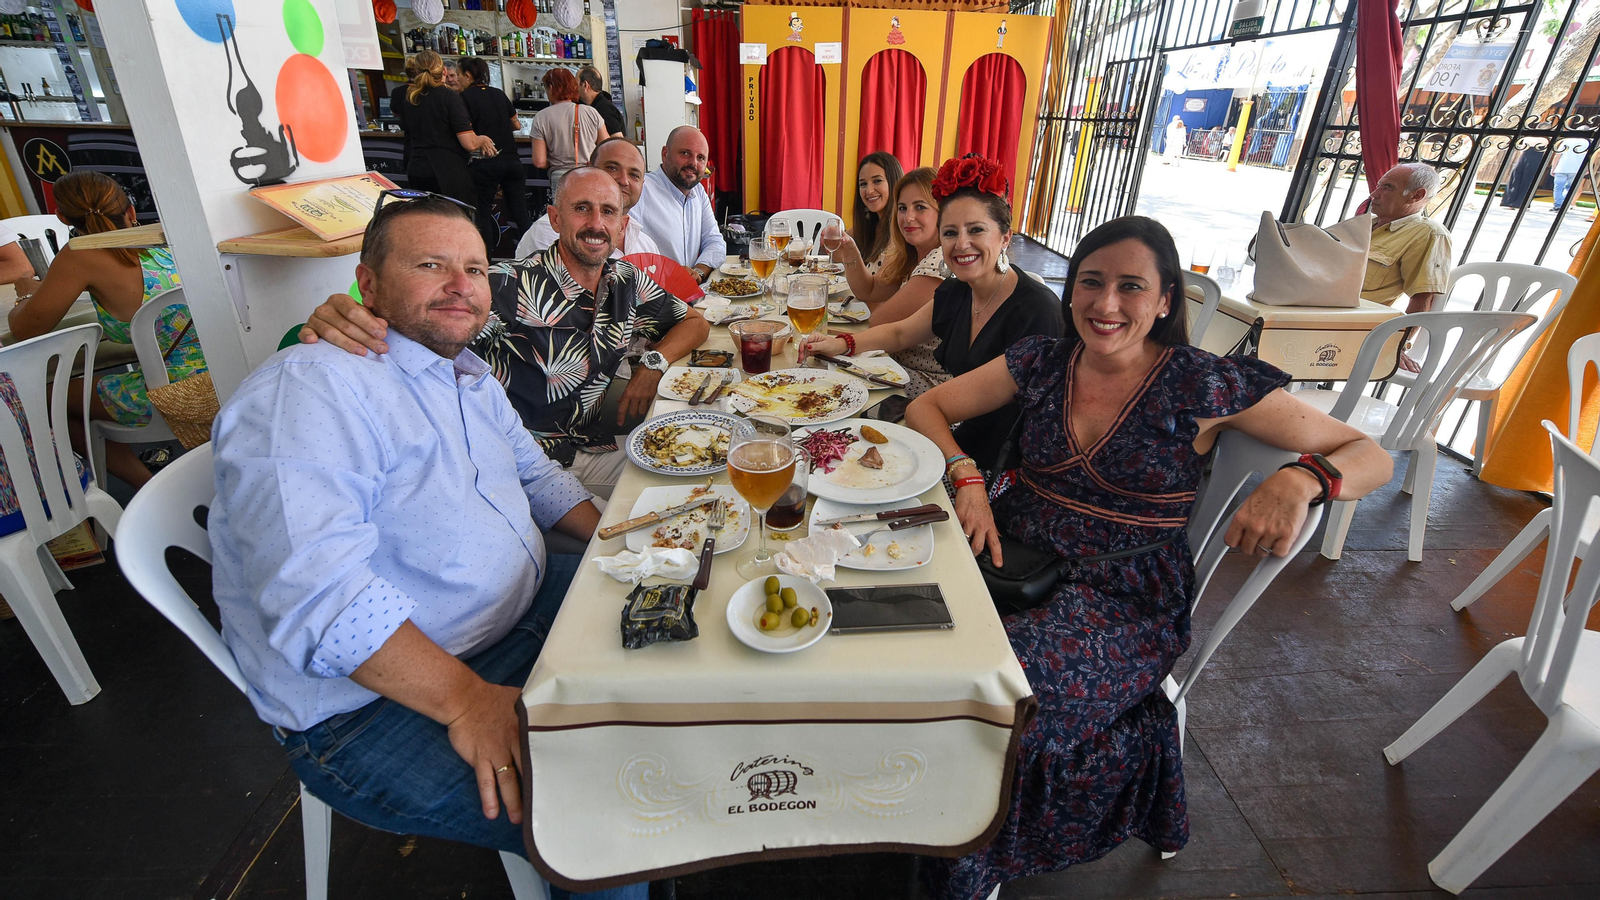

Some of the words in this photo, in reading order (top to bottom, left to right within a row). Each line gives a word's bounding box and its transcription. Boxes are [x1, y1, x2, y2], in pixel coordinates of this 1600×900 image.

[1238, 20, 1258, 29] SALIDA
[730, 754, 814, 782] Catering
[727, 805, 745, 815] EL
[748, 800, 817, 813] BODEGON
